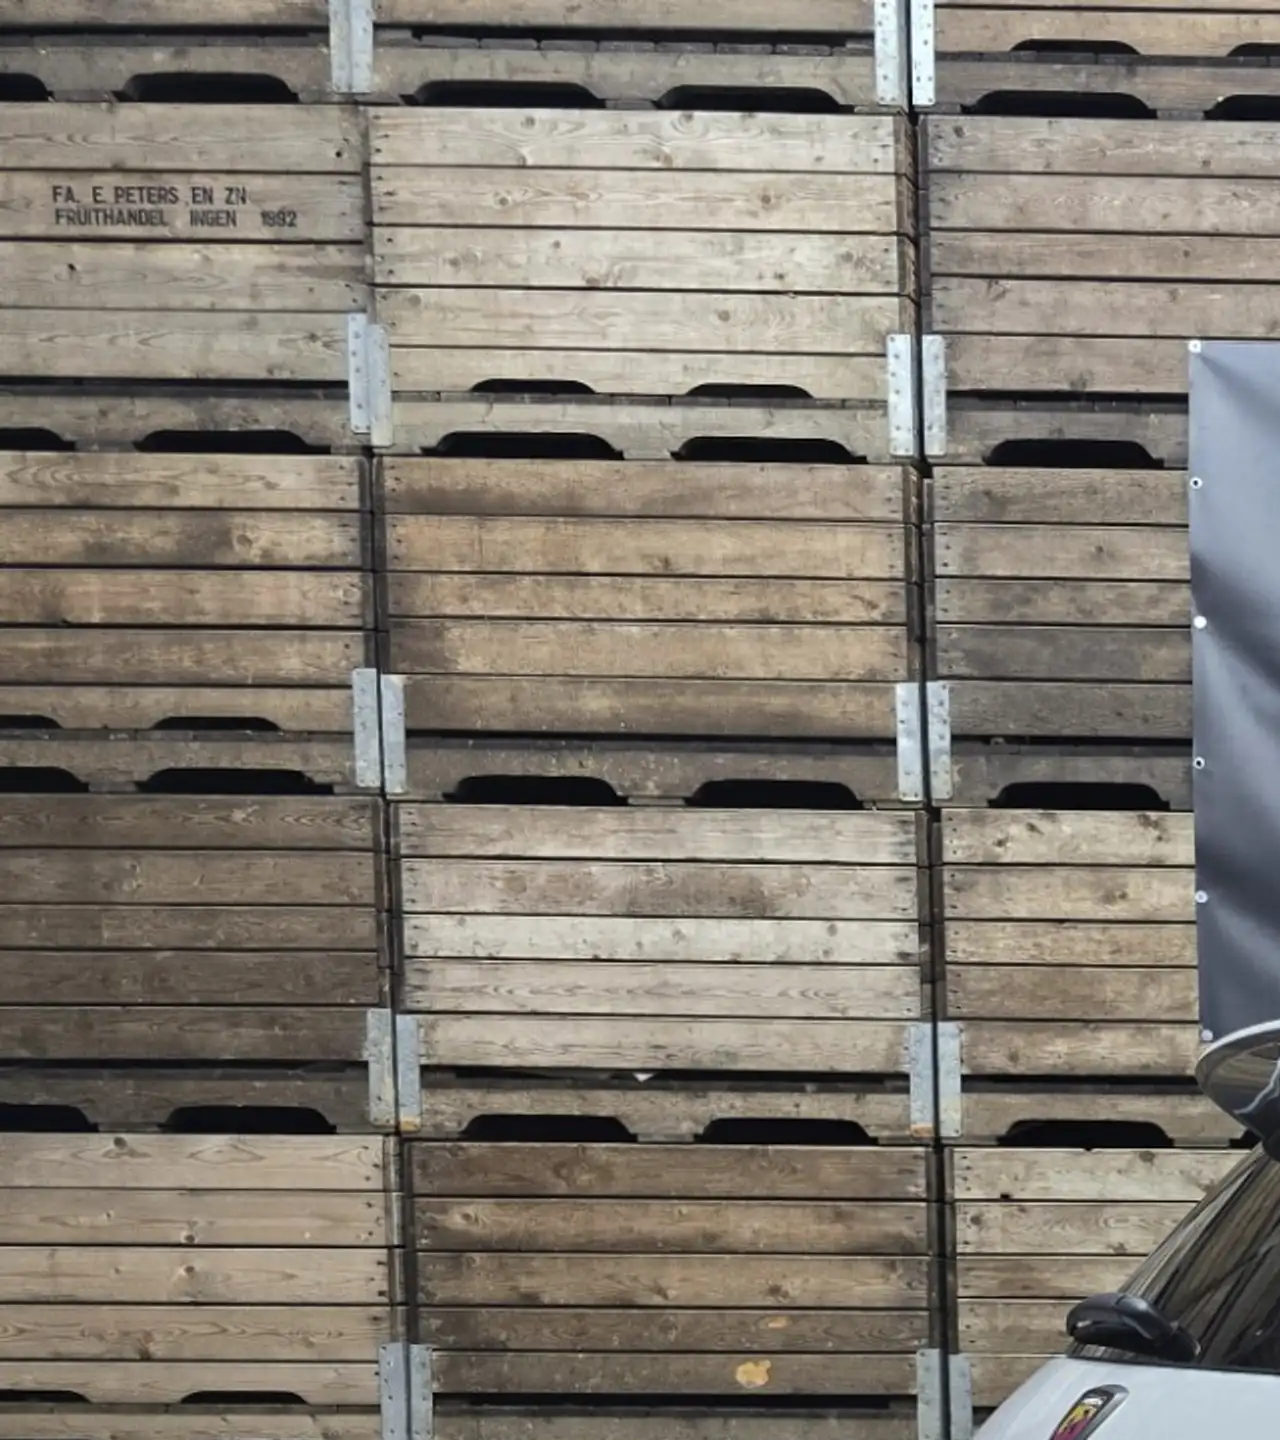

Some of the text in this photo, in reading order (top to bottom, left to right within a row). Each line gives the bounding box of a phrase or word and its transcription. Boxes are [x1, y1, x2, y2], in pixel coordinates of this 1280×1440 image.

[52, 185, 80, 203] FA.
[114, 185, 179, 205] PETERS
[191, 186, 213, 205] EN
[225, 186, 247, 206] ZN
[55, 208, 169, 226] FRUITHANDEL
[190, 209, 237, 228] INGEN
